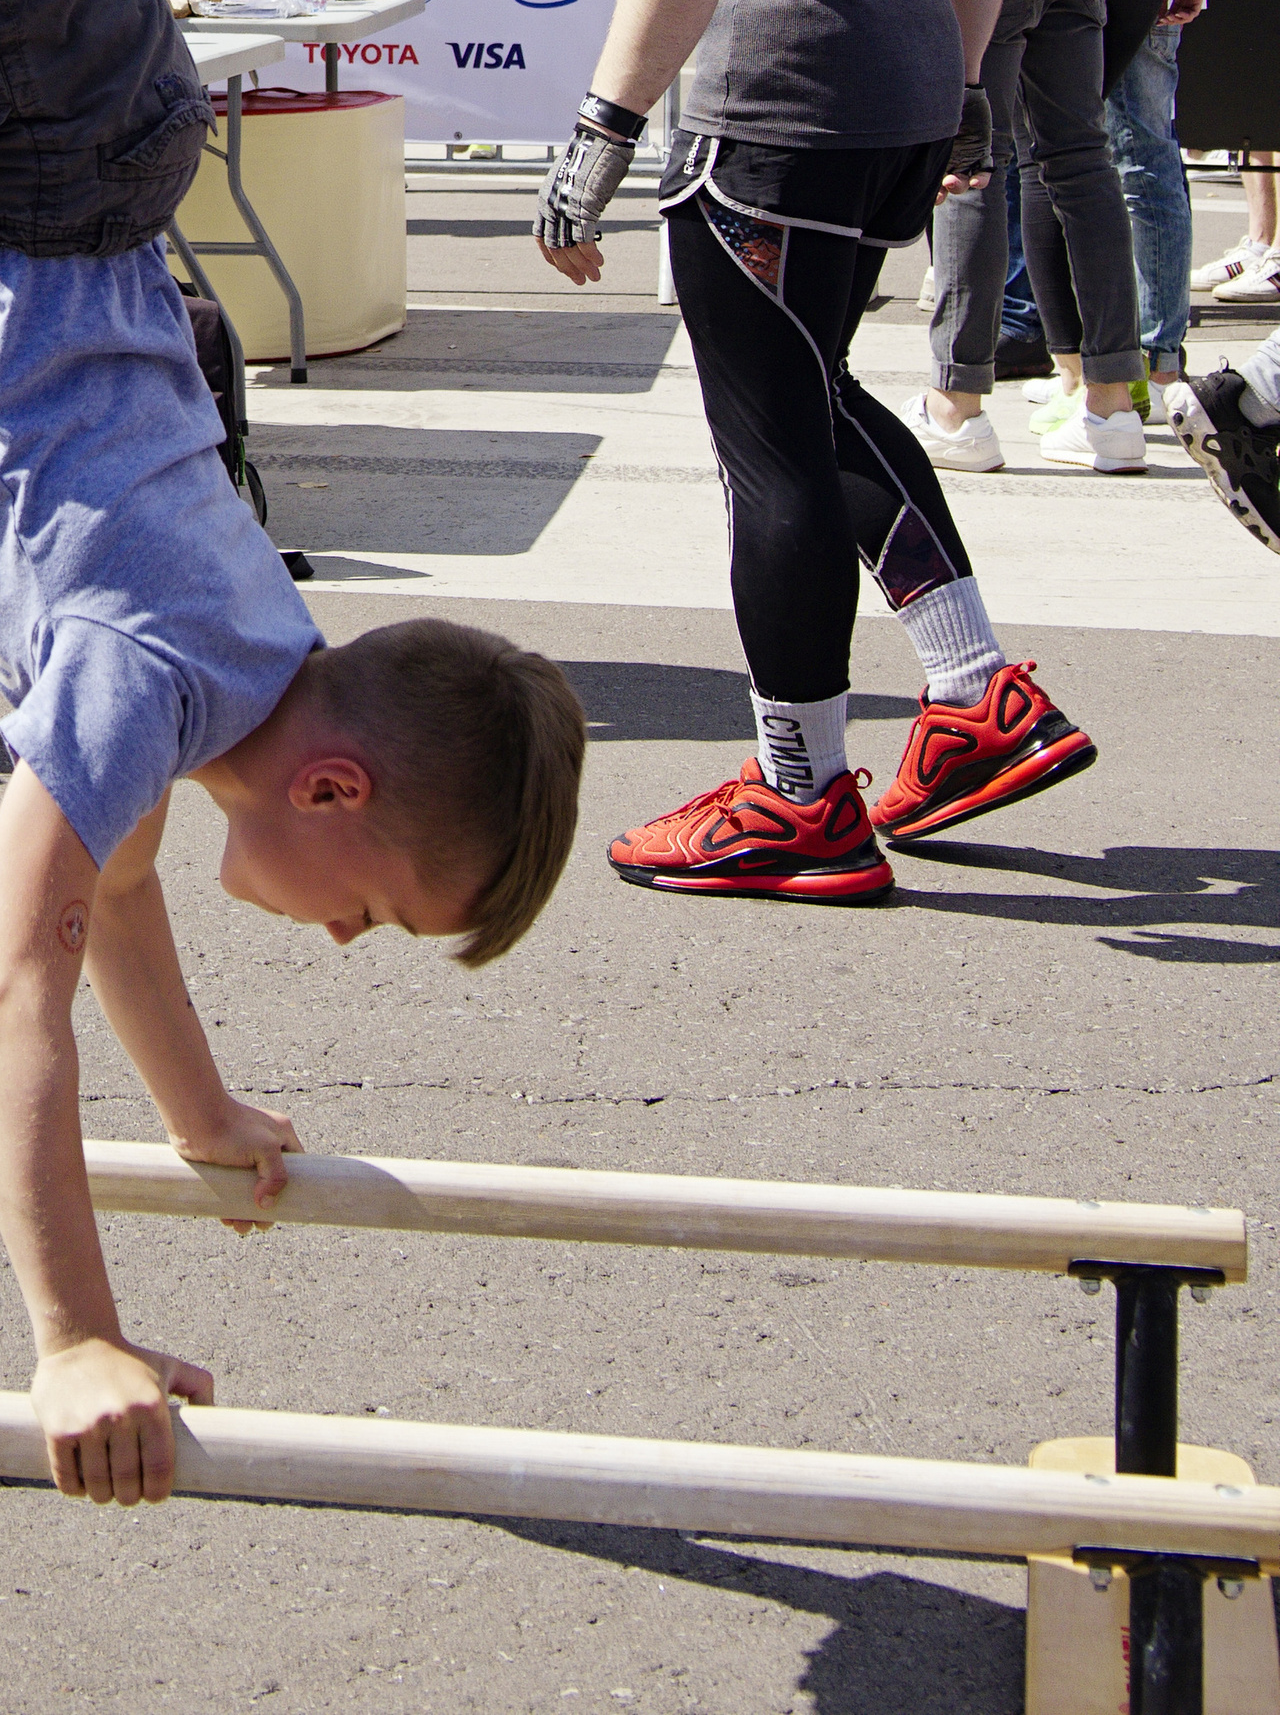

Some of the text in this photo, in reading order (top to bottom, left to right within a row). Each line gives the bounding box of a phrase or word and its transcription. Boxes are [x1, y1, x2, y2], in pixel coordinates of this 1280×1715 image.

[445, 42, 526, 69] VISA
[683, 134, 703, 175] Reebo
[762, 714, 814, 795] СТИЛЬ
